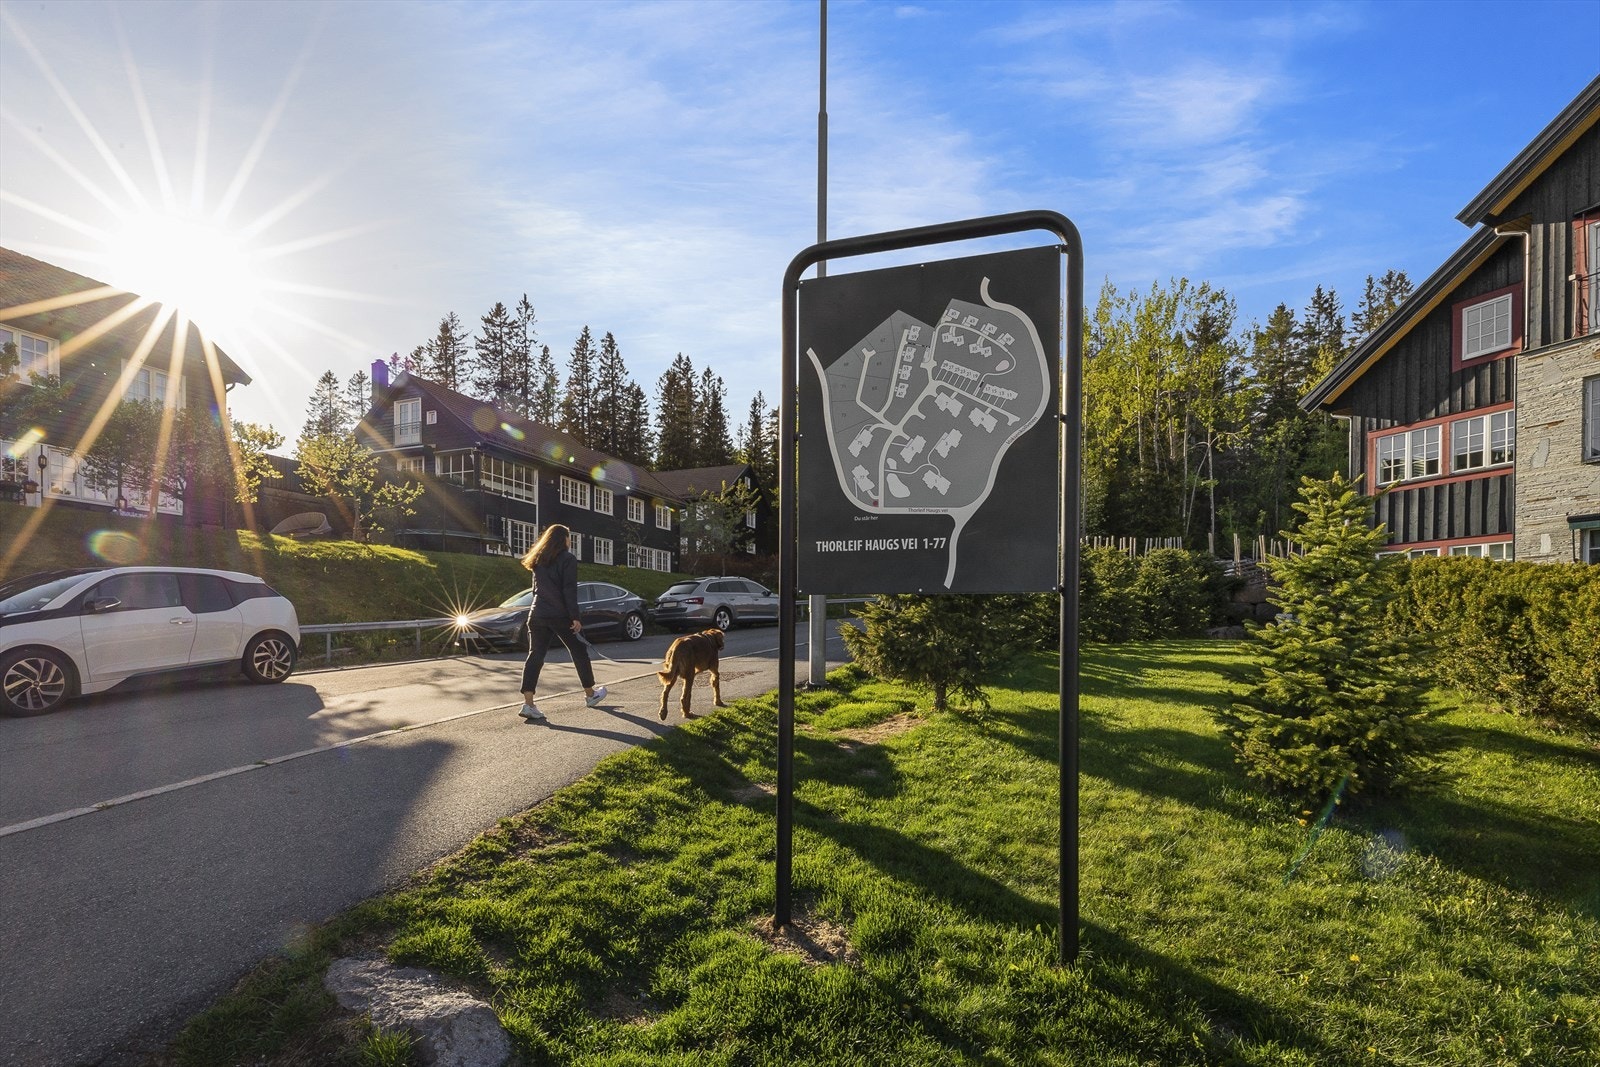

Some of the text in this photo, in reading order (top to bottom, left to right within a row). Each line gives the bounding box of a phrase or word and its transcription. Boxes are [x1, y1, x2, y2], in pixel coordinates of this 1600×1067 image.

[816, 537, 946, 552] THORLEIF HAUGS VEI 1-77
